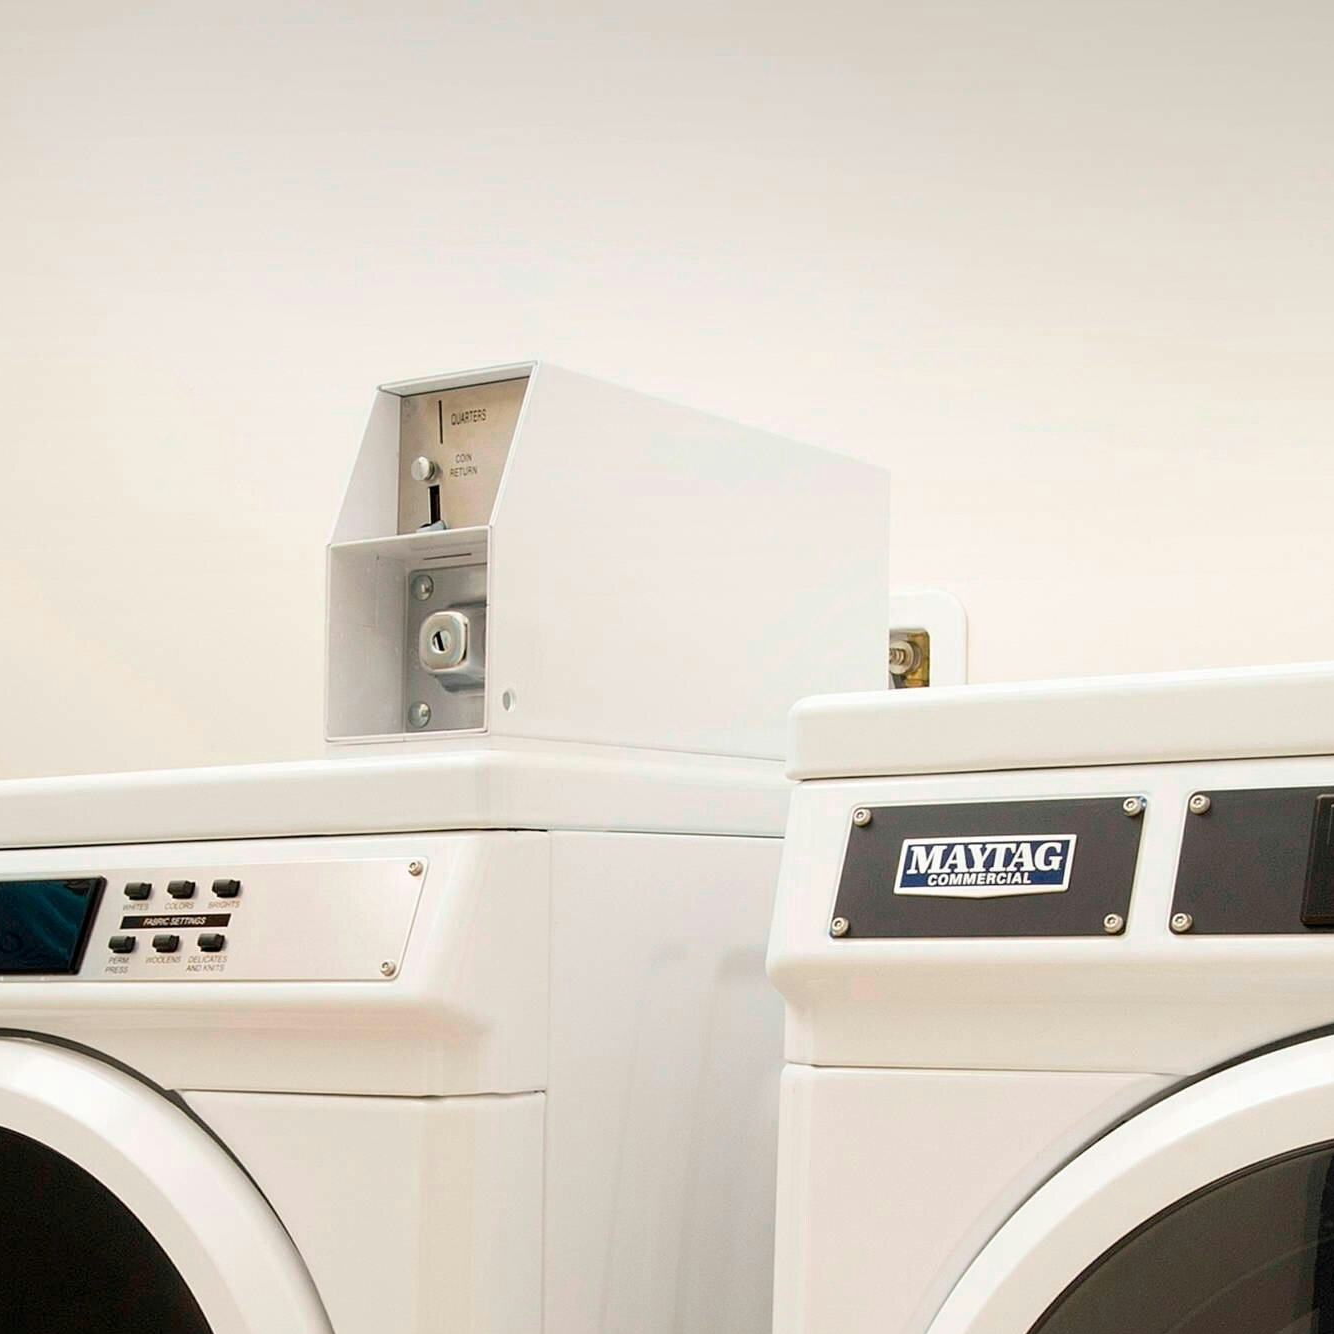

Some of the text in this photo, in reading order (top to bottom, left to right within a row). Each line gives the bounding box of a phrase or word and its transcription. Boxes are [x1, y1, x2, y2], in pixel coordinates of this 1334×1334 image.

[450, 408, 487, 426] QUARTERS
[455, 453, 472, 463] COIN
[450, 465, 478, 478] RETURN
[906, 842, 1063, 875] MAYTAG
[927, 872, 1032, 886] COMMERCIAL
[123, 902, 149, 911] WHITES
[164, 901, 194, 910] COLORS
[208, 900, 240, 909] BRIGHTS
[143, 917, 207, 926] FABRIC SETTINGS
[187, 955, 228, 963] DELICATES
